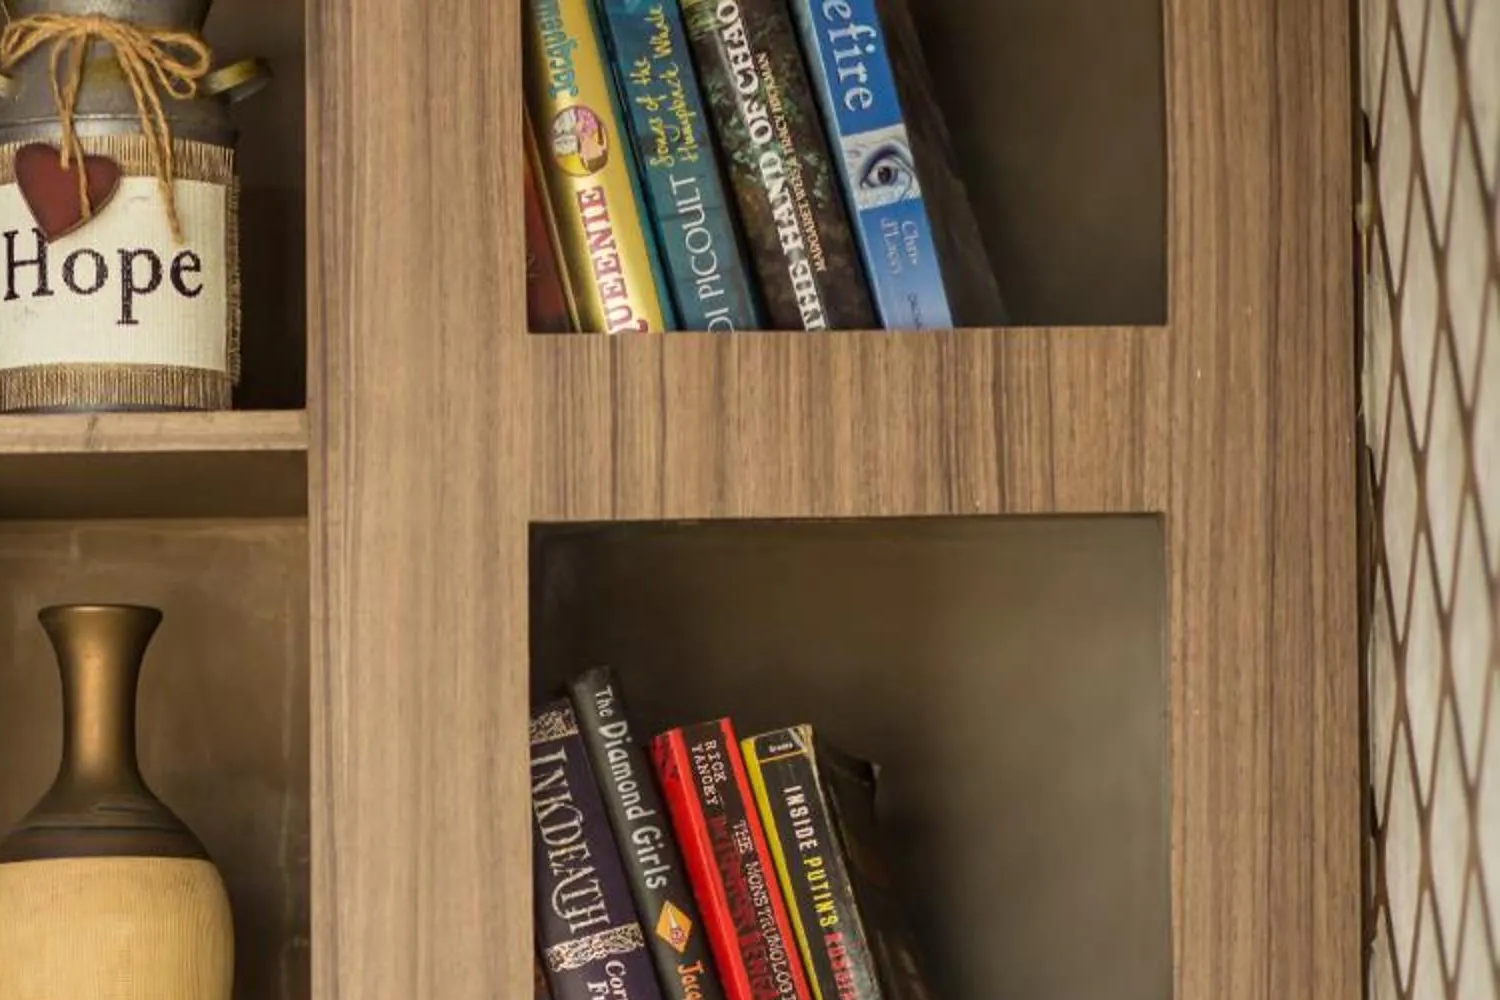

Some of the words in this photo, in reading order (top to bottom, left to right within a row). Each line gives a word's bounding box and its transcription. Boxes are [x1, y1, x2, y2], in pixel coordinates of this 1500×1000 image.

[630, 56, 651, 86] the
[716, 0, 760, 95] CHAO
[822, 0, 877, 112] efire
[636, 94, 667, 111] of
[743, 99, 773, 146] OF
[669, 174, 726, 301] PICOULT
[759, 151, 805, 256] HAND
[3, 227, 204, 325] Hope
[576, 186, 649, 333] UEENIE
[788, 259, 826, 332] THE
[595, 684, 614, 717] The
[598, 720, 655, 820] Diamond
[704, 740, 727, 783] RICK
[531, 745, 610, 935] INKDEATH
[632, 826, 671, 889] Girls
[732, 819, 754, 854] THE
[784, 785, 818, 851] INSIDE
[804, 856, 839, 927] PUTIN'S
